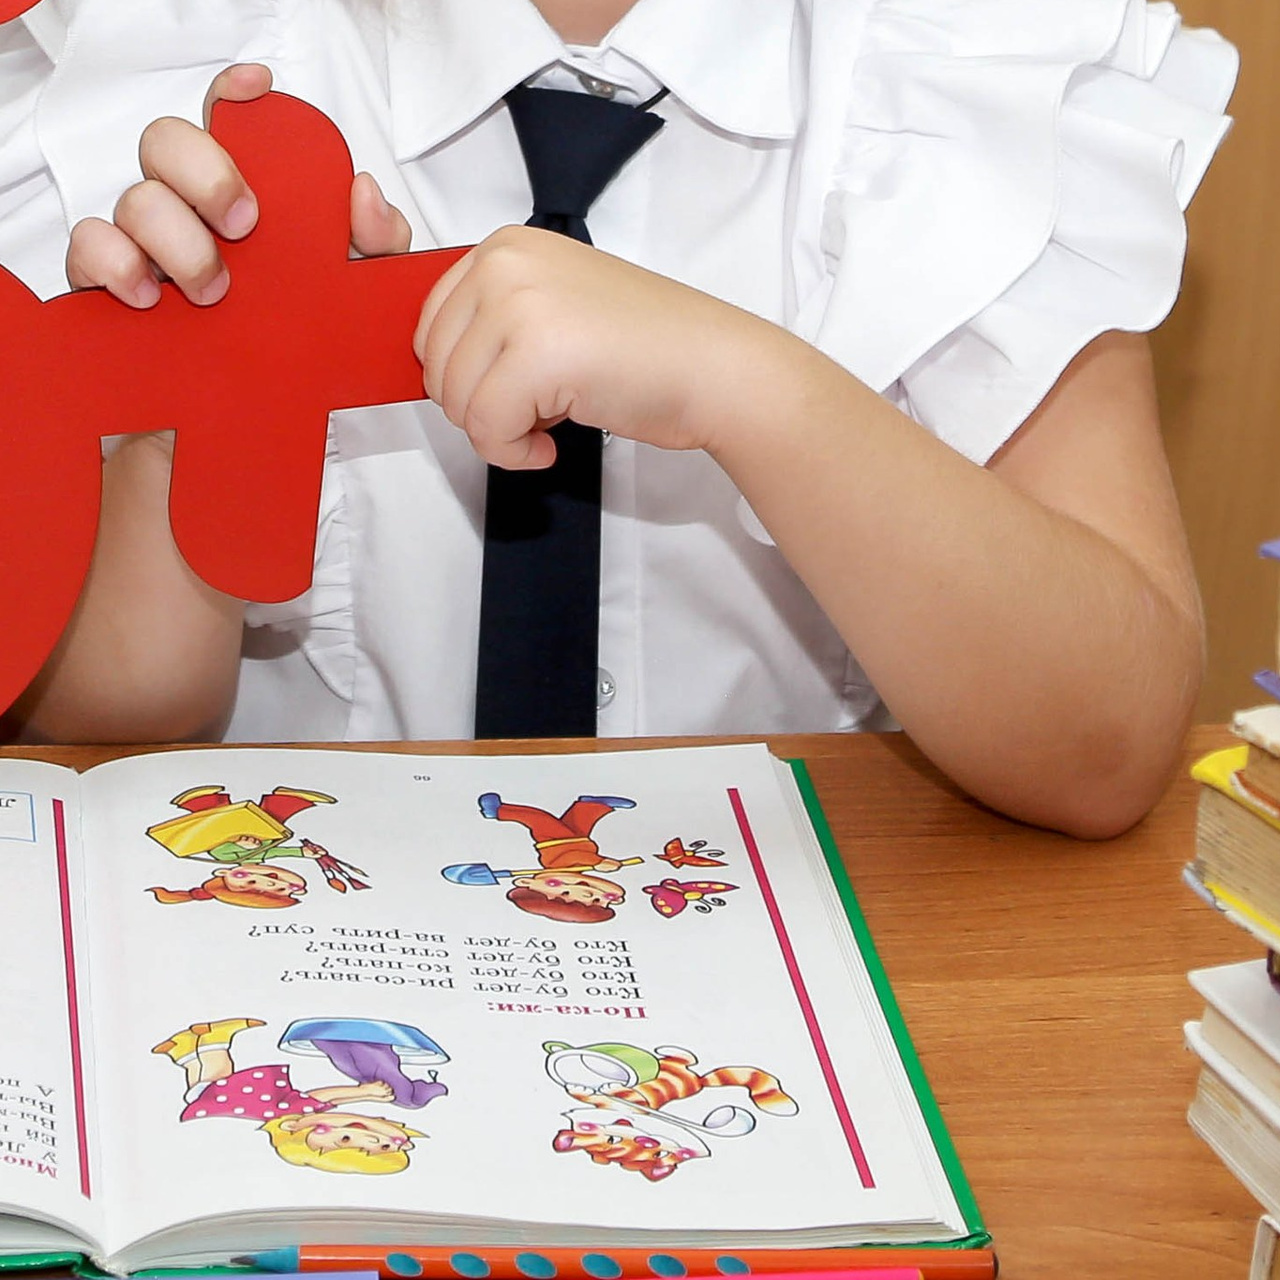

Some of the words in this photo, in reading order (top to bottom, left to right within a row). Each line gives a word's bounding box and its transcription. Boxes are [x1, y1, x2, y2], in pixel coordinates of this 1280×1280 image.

[246, 922, 313, 936] суп?
[331, 926, 444, 943] ва-рить
[303, 940, 448, 958] сти-рать?
[463, 936, 556, 951] бу-дет
[572, 939, 629, 952] Кто
[319, 955, 450, 973] ко-пать?
[465, 951, 559, 966] бу-дет
[576, 954, 633, 967] Кто
[278, 969, 454, 989] ри-со-вать?
[469, 966, 563, 982] бу-дет
[580, 970, 638, 983] Кто
[472, 982, 567, 997] бу-дет
[584, 986, 642, 998] Кто
[486, 1001, 646, 1018] По-ка-жи:
[35, 1084, 54, 1097] А
[24, 1128, 56, 1146] Ей
[40, 1150, 56, 1164] У
